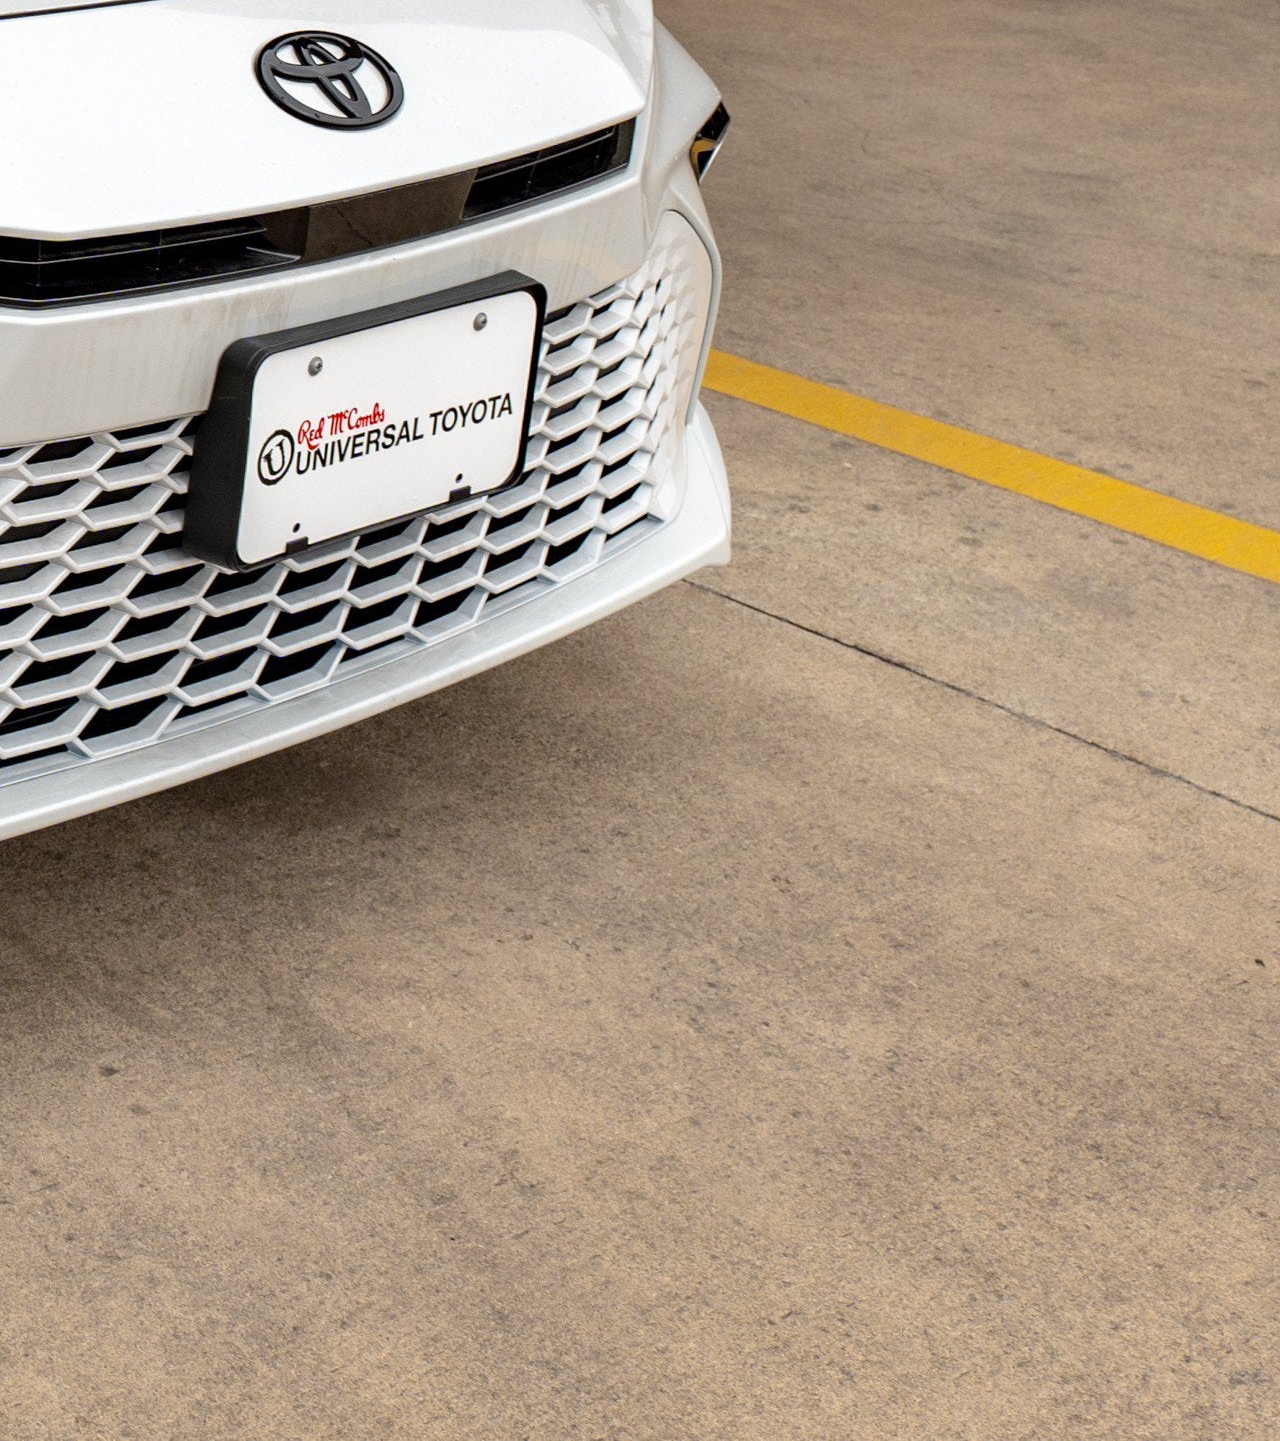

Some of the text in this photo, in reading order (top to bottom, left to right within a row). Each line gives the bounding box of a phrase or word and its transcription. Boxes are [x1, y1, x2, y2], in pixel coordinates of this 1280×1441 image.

[296, 393, 513, 474] UNIVERSAL TOYOTA
[298, 403, 386, 450] Red McCombs
